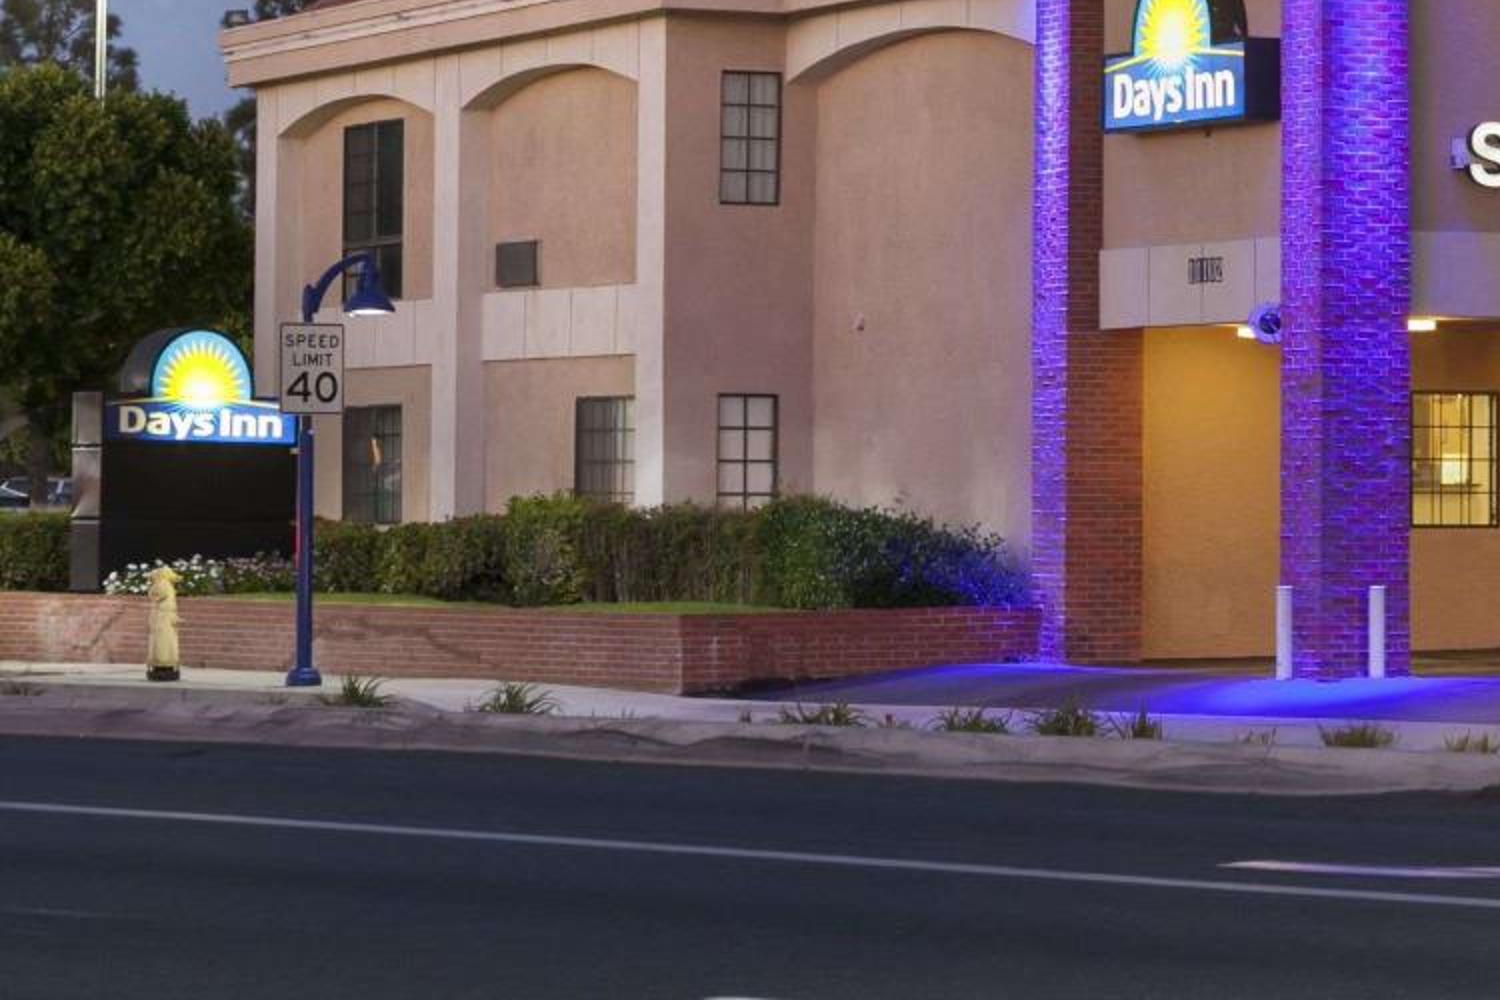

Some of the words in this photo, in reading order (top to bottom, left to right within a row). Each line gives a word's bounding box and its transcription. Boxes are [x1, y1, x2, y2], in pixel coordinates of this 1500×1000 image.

[1112, 71, 1181, 121] Days
[1186, 68, 1235, 109] Inn
[285, 333, 340, 349] SPEED
[292, 353, 332, 368] LIMIT
[286, 371, 339, 404] 40
[118, 405, 214, 440] Days
[220, 409, 283, 438] Inn
